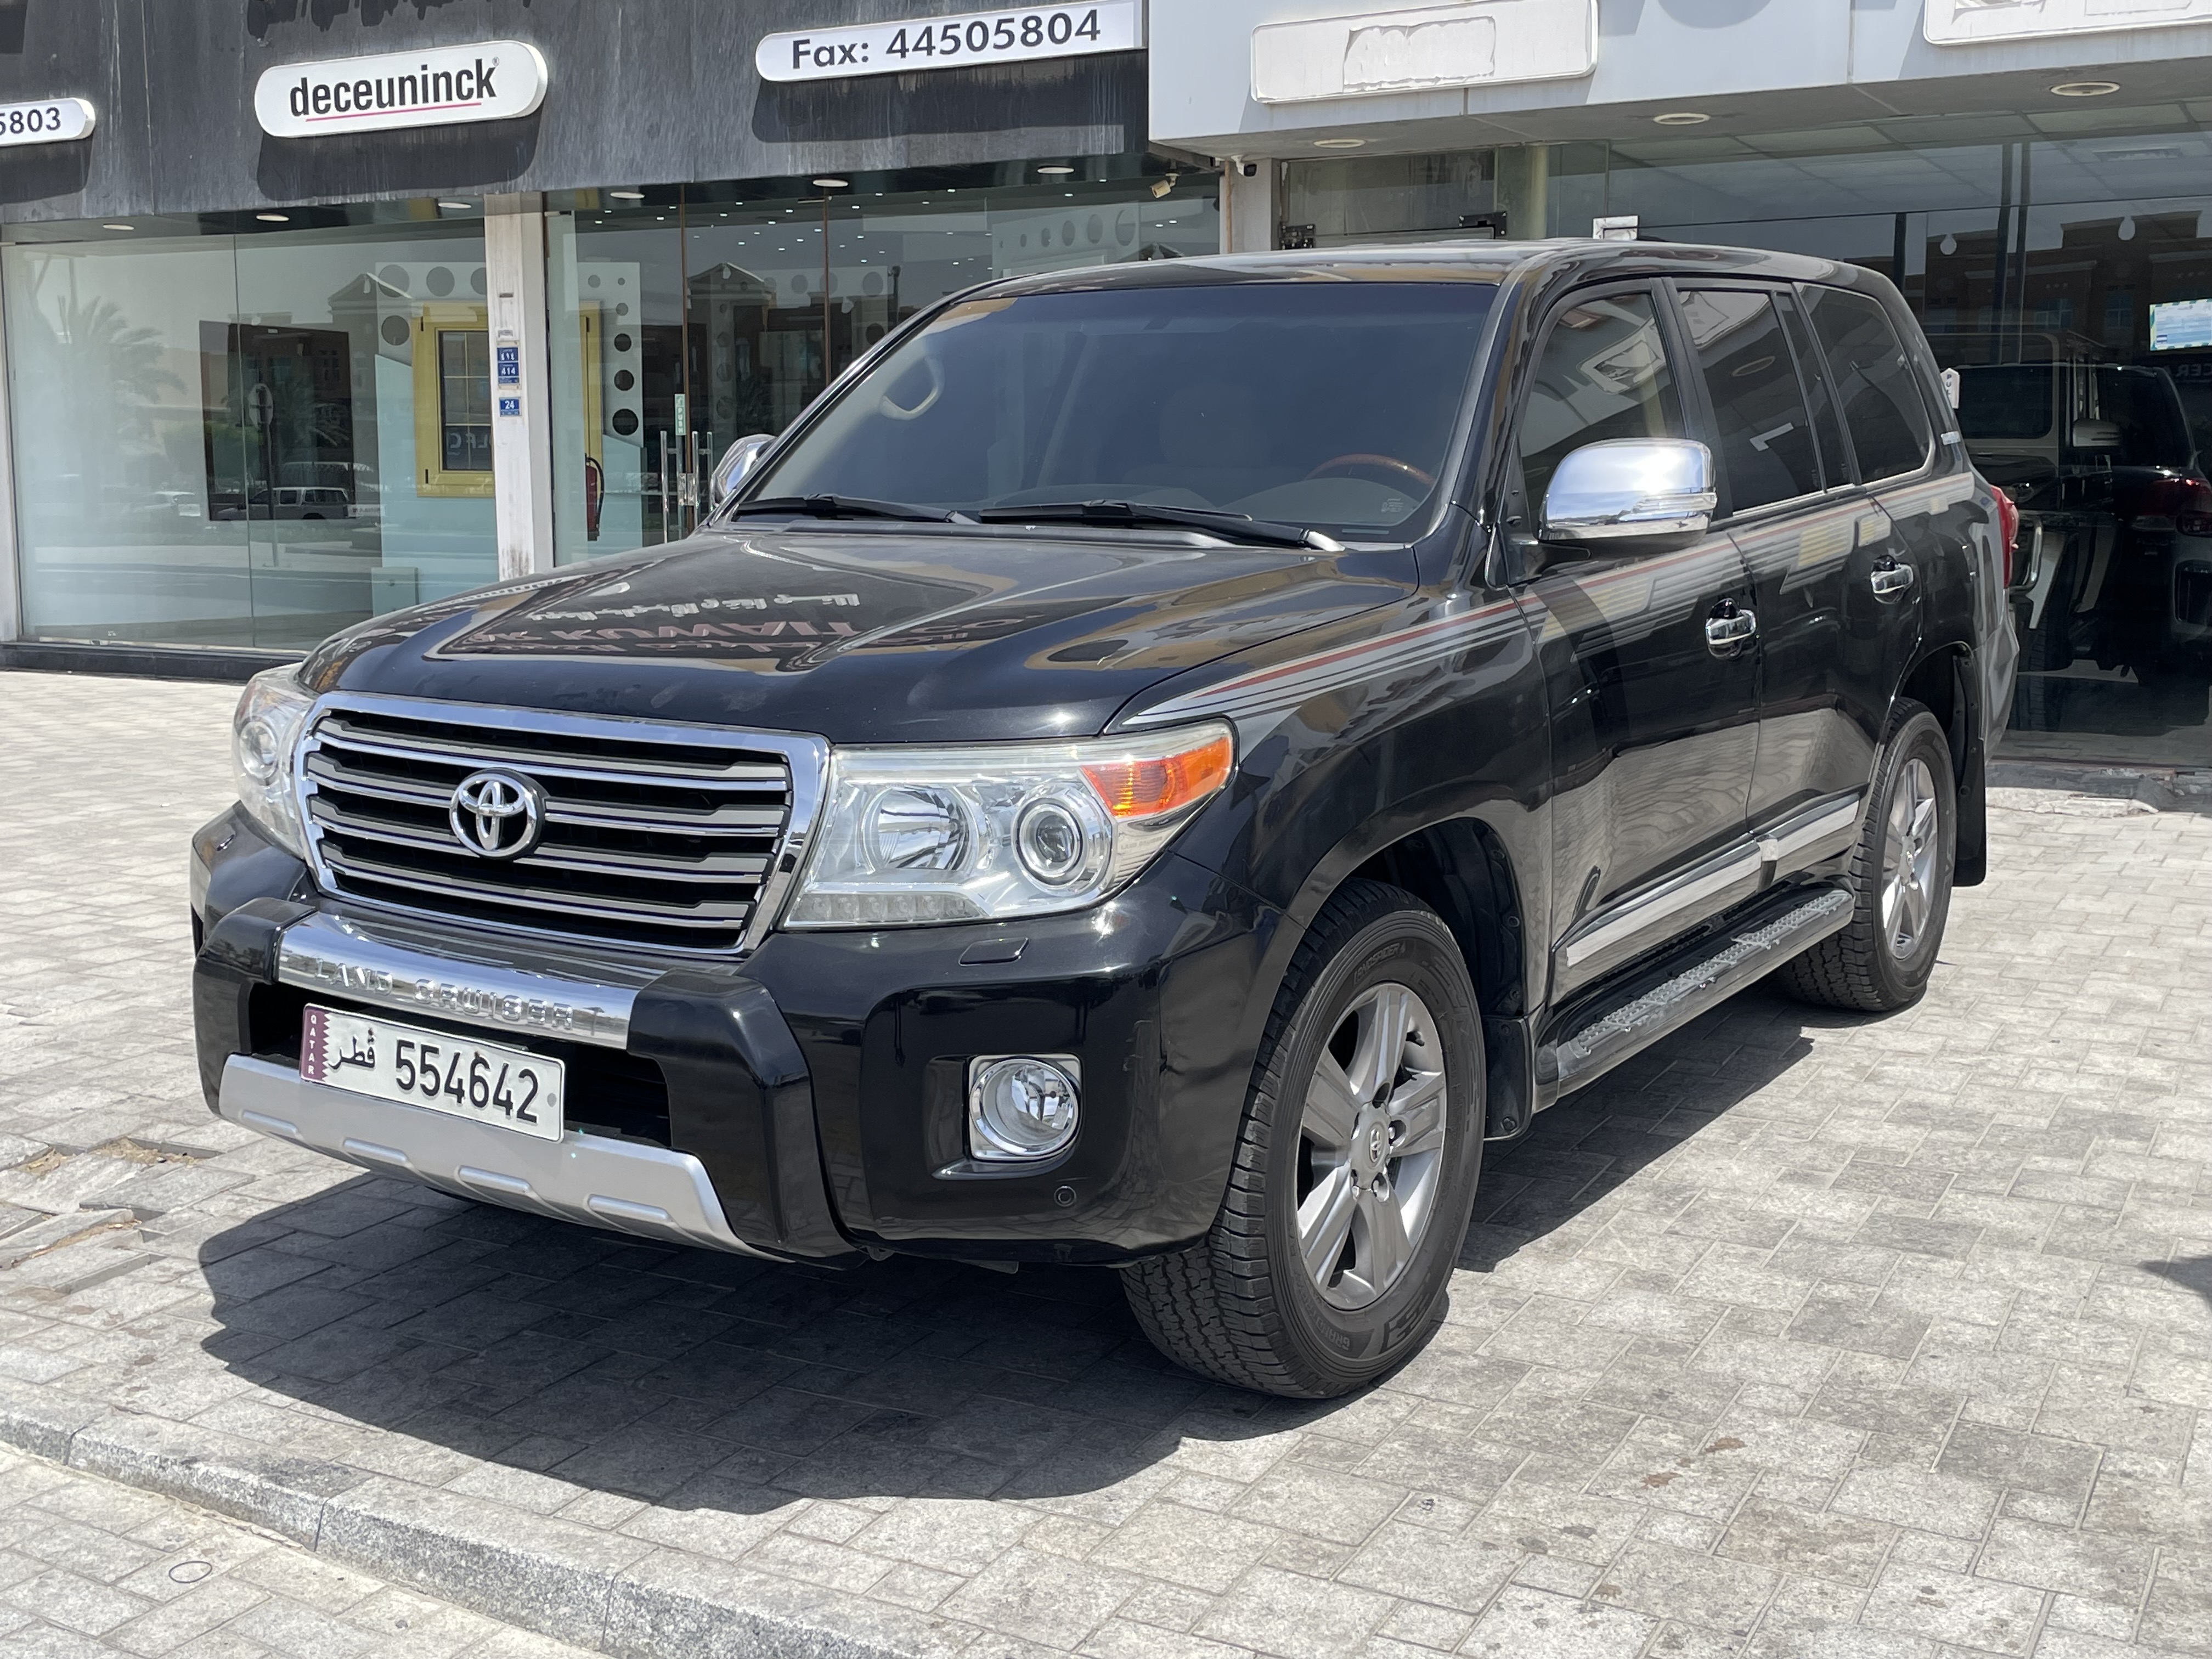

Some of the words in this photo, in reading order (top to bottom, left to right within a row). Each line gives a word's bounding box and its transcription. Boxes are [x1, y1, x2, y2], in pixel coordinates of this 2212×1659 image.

[792, 38, 869, 70] Fax:
[885, 8, 1101, 59] 44505804
[290, 58, 497, 117] deceuninck
[501, 366, 516, 375] 414
[504, 400, 515, 409] 24
[315, 958, 393, 995] LAND
[414, 978, 574, 1030] CRUISER
[306, 1014, 318, 1075] QATAR
[330, 1028, 376, 1070] قطر
[395, 1039, 539, 1124] 554642
